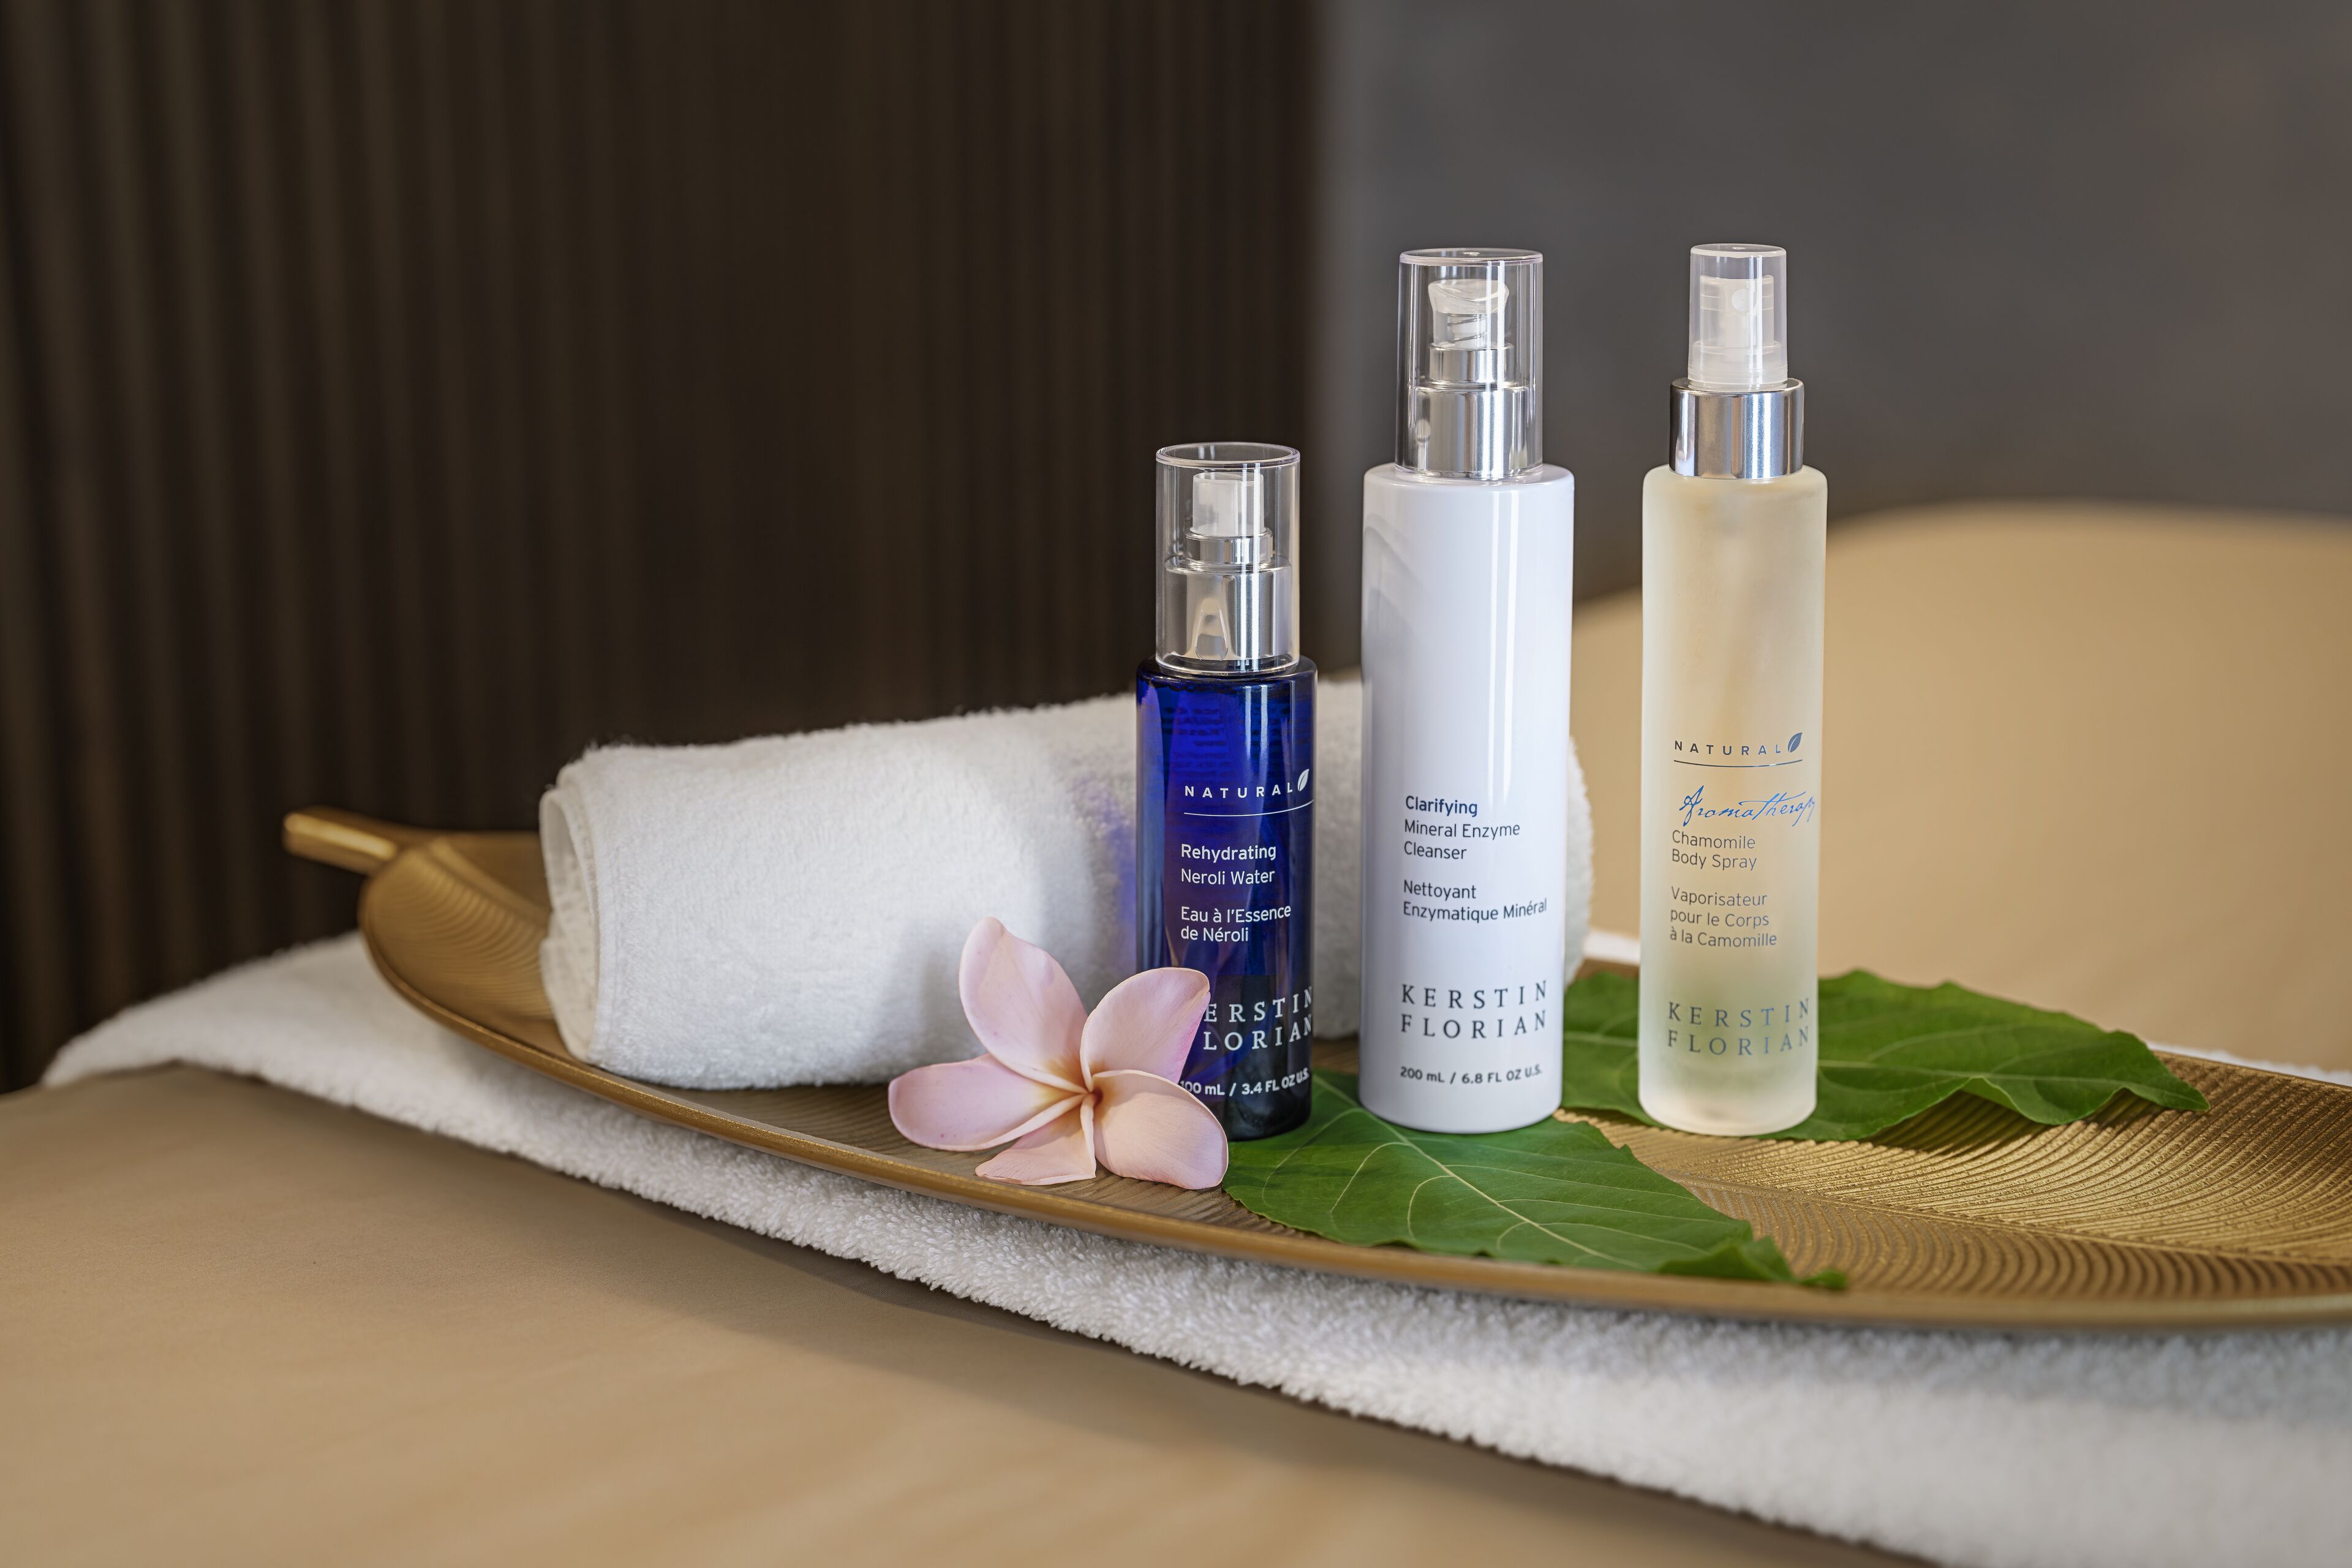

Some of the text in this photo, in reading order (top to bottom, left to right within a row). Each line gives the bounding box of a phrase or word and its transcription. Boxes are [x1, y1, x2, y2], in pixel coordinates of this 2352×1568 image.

[1674, 740, 1781, 756] NATURAL
[1185, 782, 1294, 799] NATURAL
[1406, 796, 1478, 818] Clarifying
[1404, 818, 1520, 840] Mineral Enzyme
[1672, 829, 1756, 850] Chamomile
[1181, 843, 1276, 863] Rehydrating
[1404, 841, 1467, 859] Cleanser
[1672, 848, 1757, 871] Body Spray
[1181, 869, 1275, 885] Neroli Water
[1404, 880, 1477, 901] Nettoyant
[1671, 886, 1768, 907] Vaporisateur
[1181, 906, 1208, 922] Eau
[1213, 908, 1222, 923] à
[1403, 897, 1547, 924] Enzymatique Minéral
[1670, 909, 1770, 929] pour le Corps
[1181, 925, 1249, 942] de Néroli
[1670, 925, 1777, 948] à la Camomille
[1204, 986, 1313, 1023] ERSTIN
[1401, 979, 1547, 1009] KERSTIN
[1668, 998, 1809, 1028] KERSTIN
[1203, 1013, 1312, 1050] LORIAN
[1401, 1009, 1546, 1039] FLORIAN
[1668, 1026, 1808, 1056] FLORIAN
[1205, 1084, 1225, 1095] mL
[1229, 1082, 1237, 1096] /
[1242, 1082, 1262, 1095] 3.4
[1265, 1079, 1280, 1092] FL
[1281, 1074, 1295, 1089] OZ
[1400, 1066, 1423, 1080] 200
[1427, 1071, 1445, 1083] mL
[1450, 1072, 1457, 1084] /
[1461, 1072, 1483, 1084] 6.8
[1487, 1072, 1502, 1083] FL
[1506, 1068, 1521, 1081] OZ
